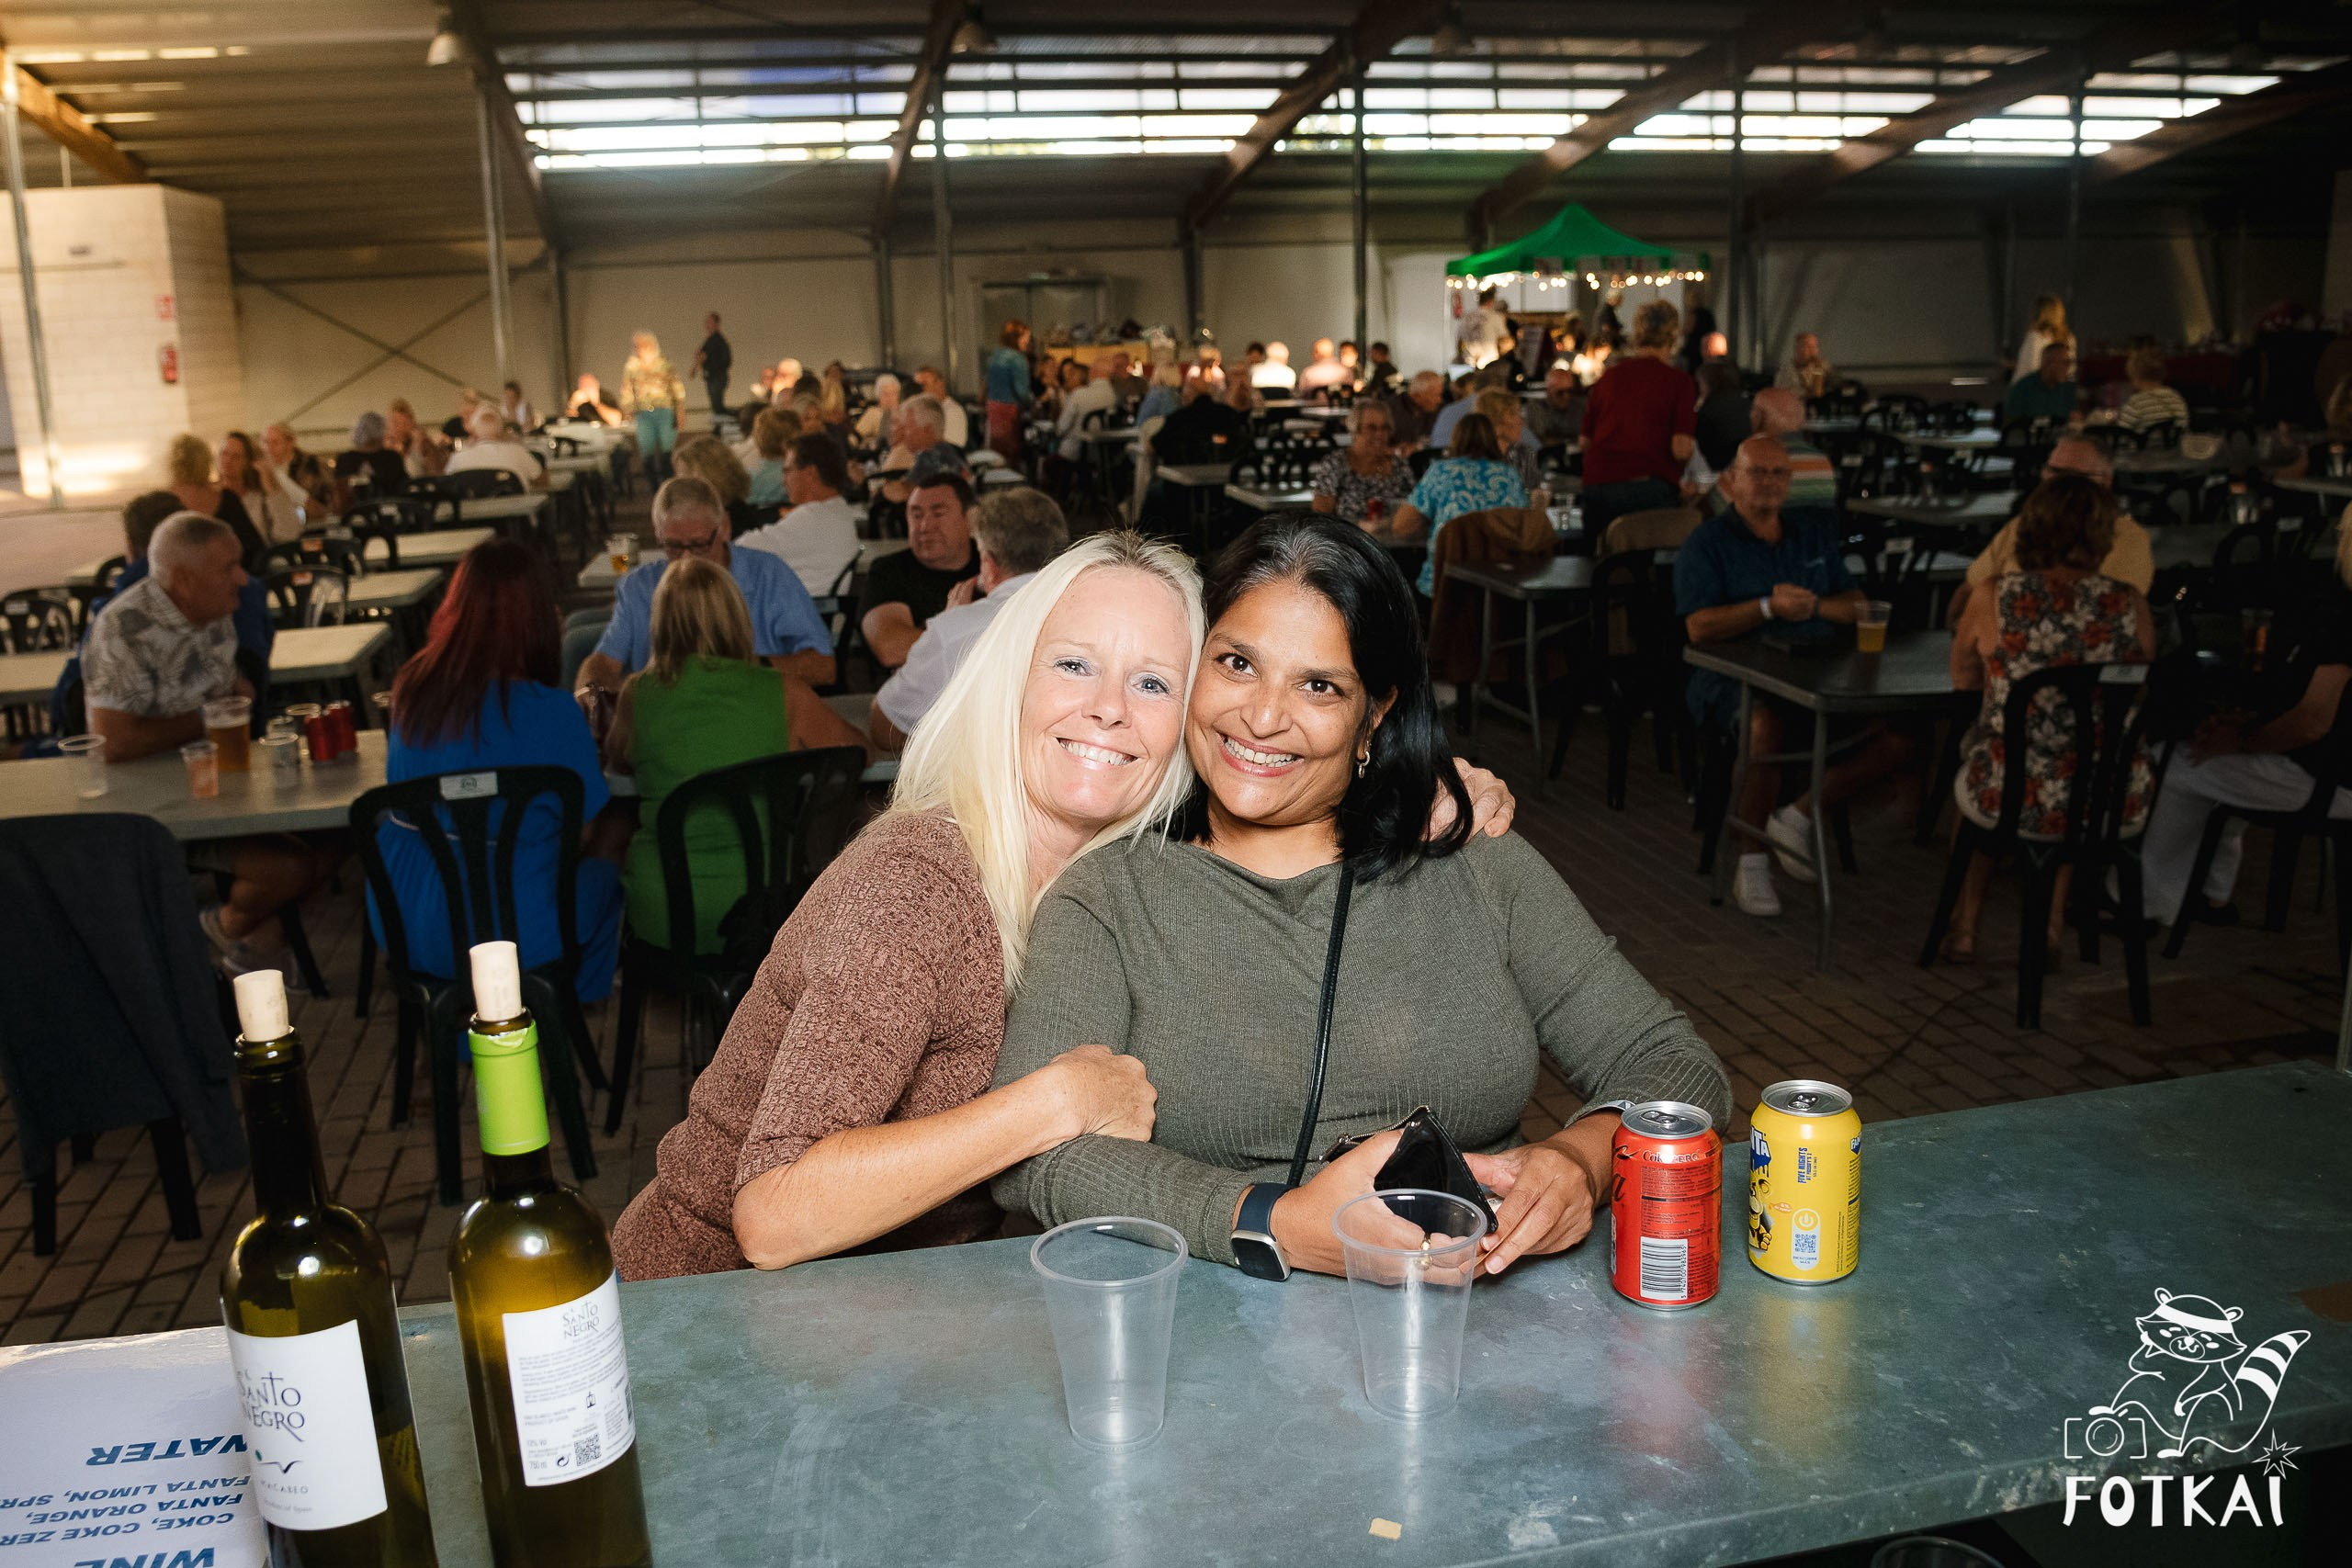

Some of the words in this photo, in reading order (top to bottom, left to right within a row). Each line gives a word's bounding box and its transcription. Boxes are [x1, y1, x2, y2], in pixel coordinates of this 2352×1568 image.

[1642, 1150, 1667, 1163] Cok
[562, 1301, 599, 1327] SANTO
[563, 1316, 600, 1339] NEGRO
[64, 1484, 158, 1503] LIMON,
[167, 1475, 251, 1493] FANTA
[158, 1493, 243, 1512] FANTA
[26, 1504, 147, 1525] ORANGE,
[152, 1513, 234, 1530] COKE,
[61, 1523, 141, 1540] COKE
